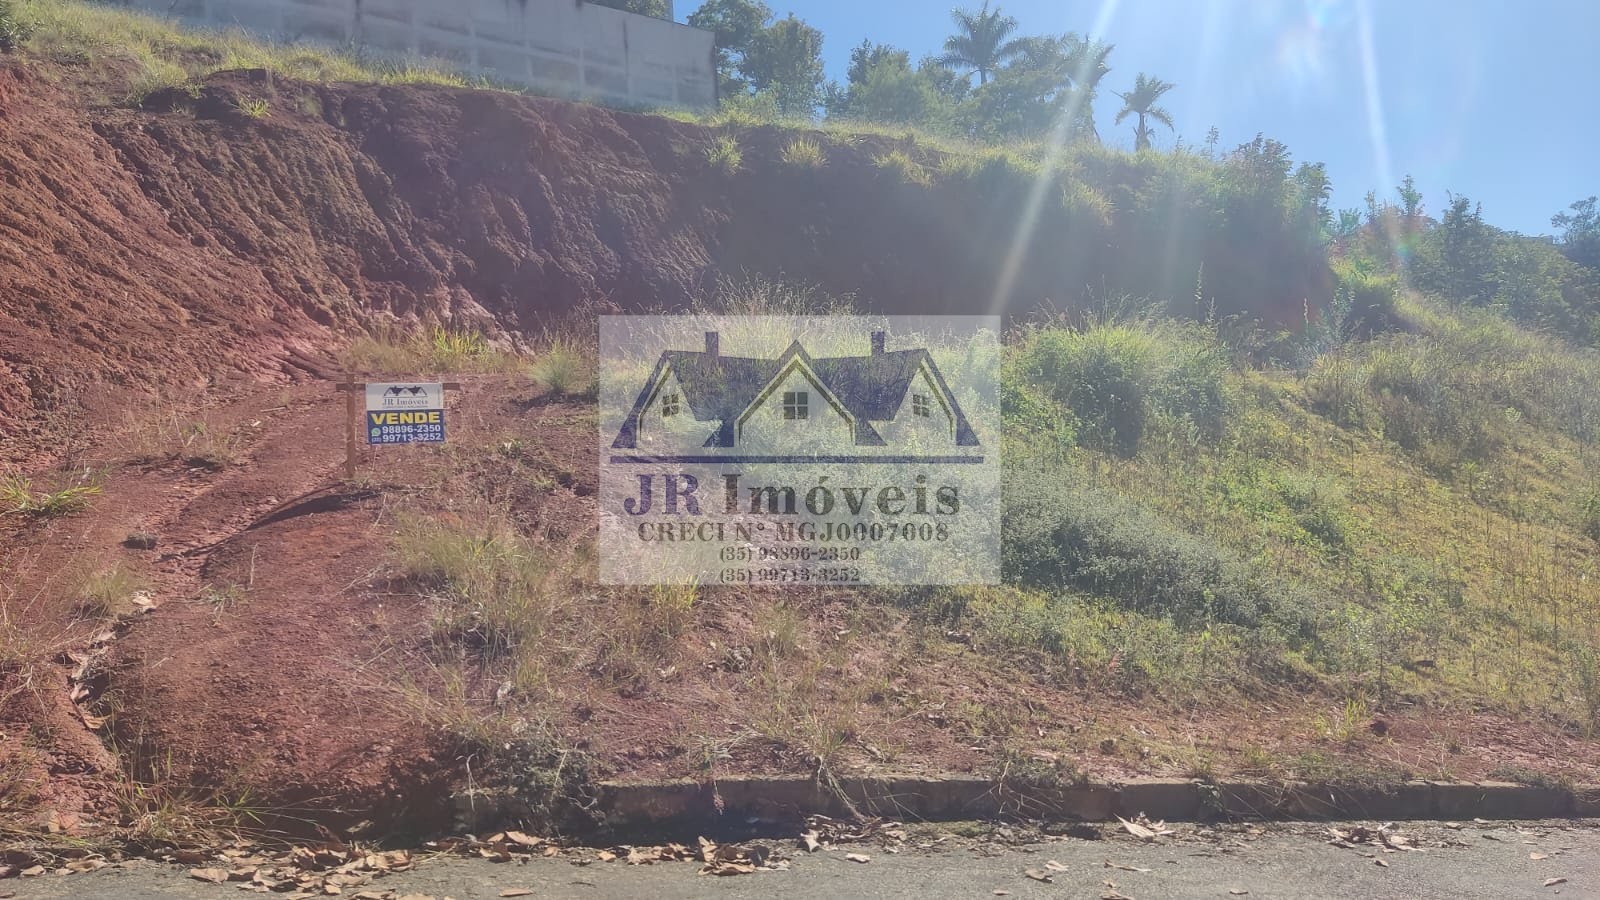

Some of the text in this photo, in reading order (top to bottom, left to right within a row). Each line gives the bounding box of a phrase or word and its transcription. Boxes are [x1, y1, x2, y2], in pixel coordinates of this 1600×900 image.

[371, 412, 440, 425] VENDE
[382, 424, 441, 434] 98896-2350
[382, 433, 441, 442] 99713-3252
